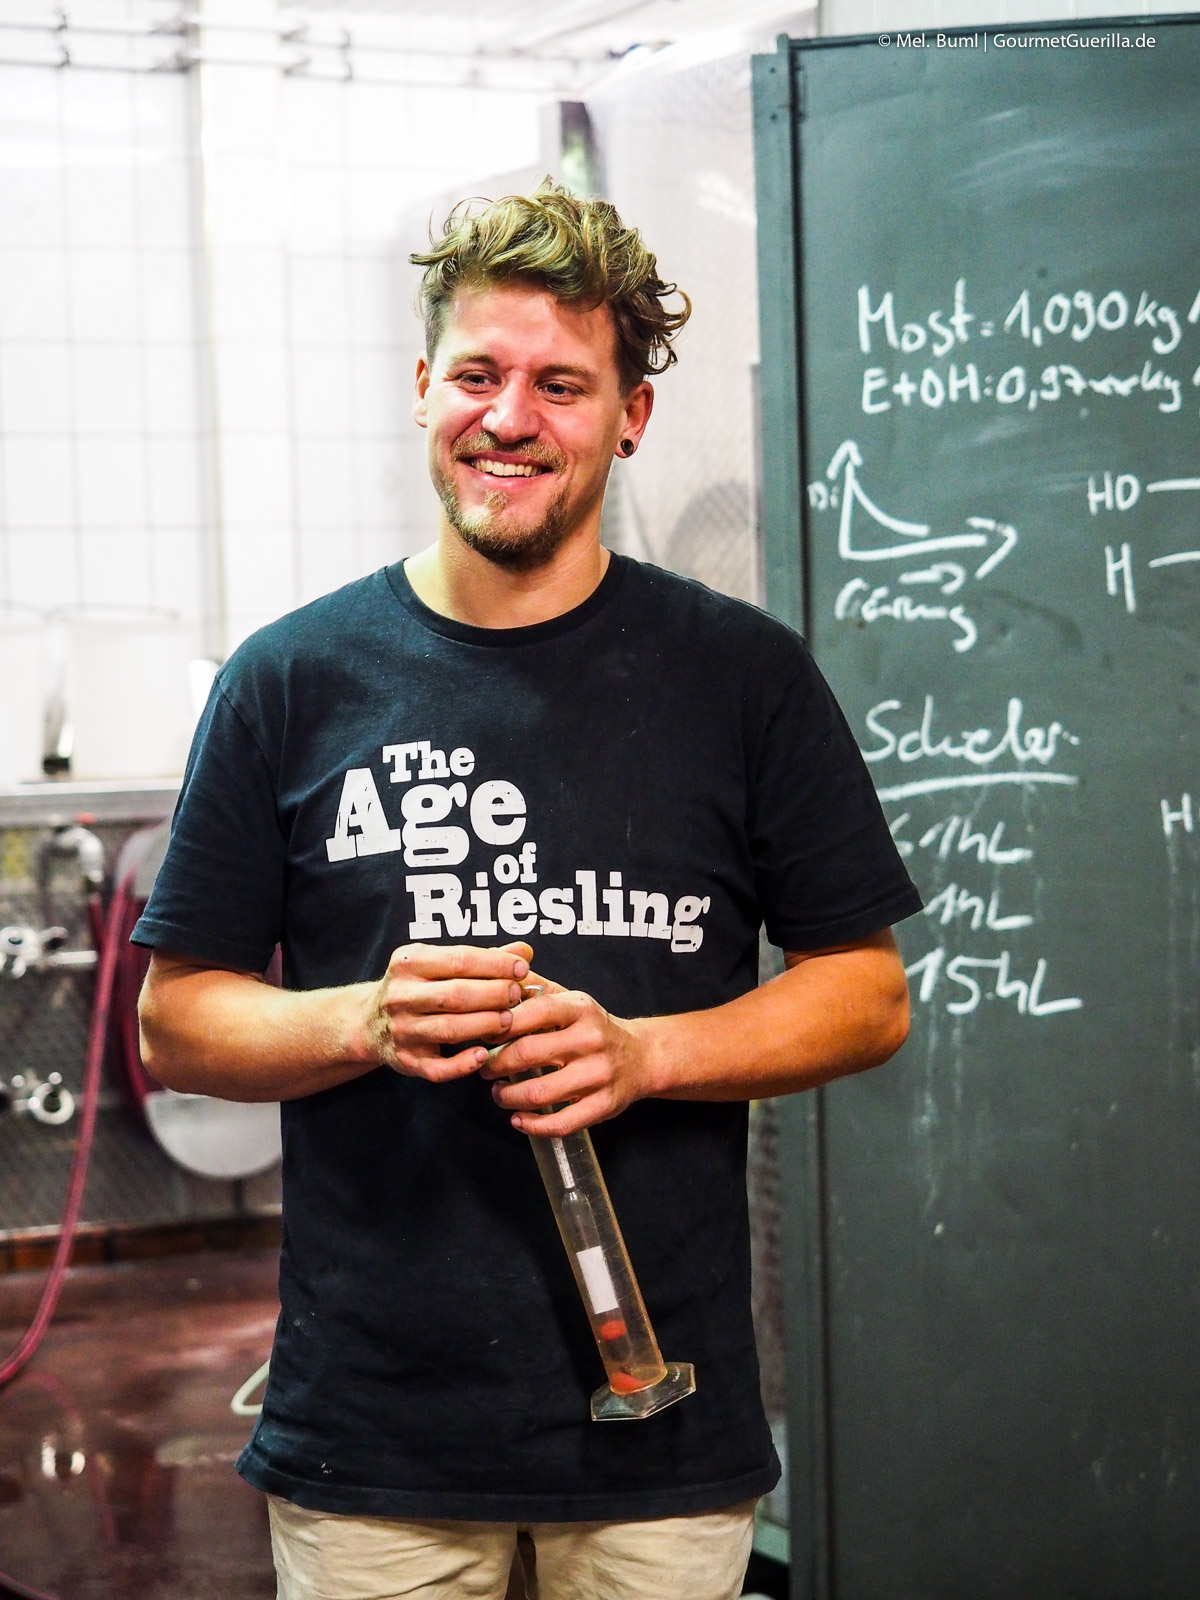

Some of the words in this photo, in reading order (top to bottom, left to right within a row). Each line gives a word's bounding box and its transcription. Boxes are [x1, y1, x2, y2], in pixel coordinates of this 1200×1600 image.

[1104, 542, 1137, 613] H
[383, 740, 475, 783] The
[326, 768, 527, 867] Age
[494, 842, 537, 883] of
[405, 870, 711, 953] Riesling
